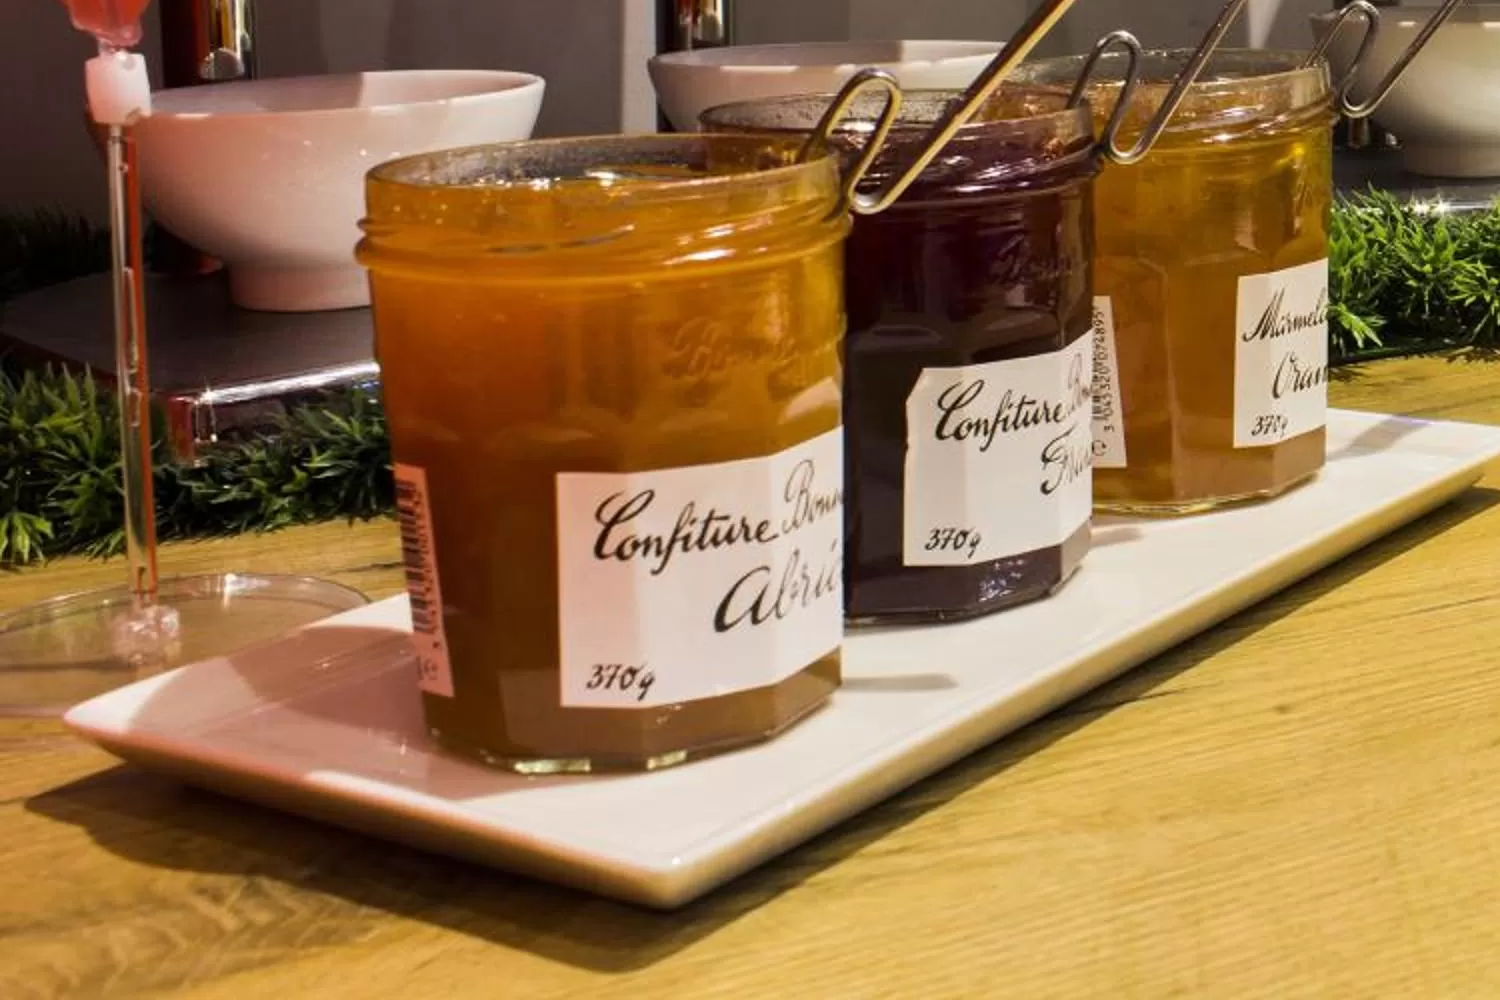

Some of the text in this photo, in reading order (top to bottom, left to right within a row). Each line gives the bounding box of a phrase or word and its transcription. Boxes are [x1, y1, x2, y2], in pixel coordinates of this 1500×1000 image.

[935, 379, 1064, 453] Confiture
[593, 488, 780, 577] Confiture
[924, 527, 983, 560] 370g
[586, 663, 656, 702] 370g
